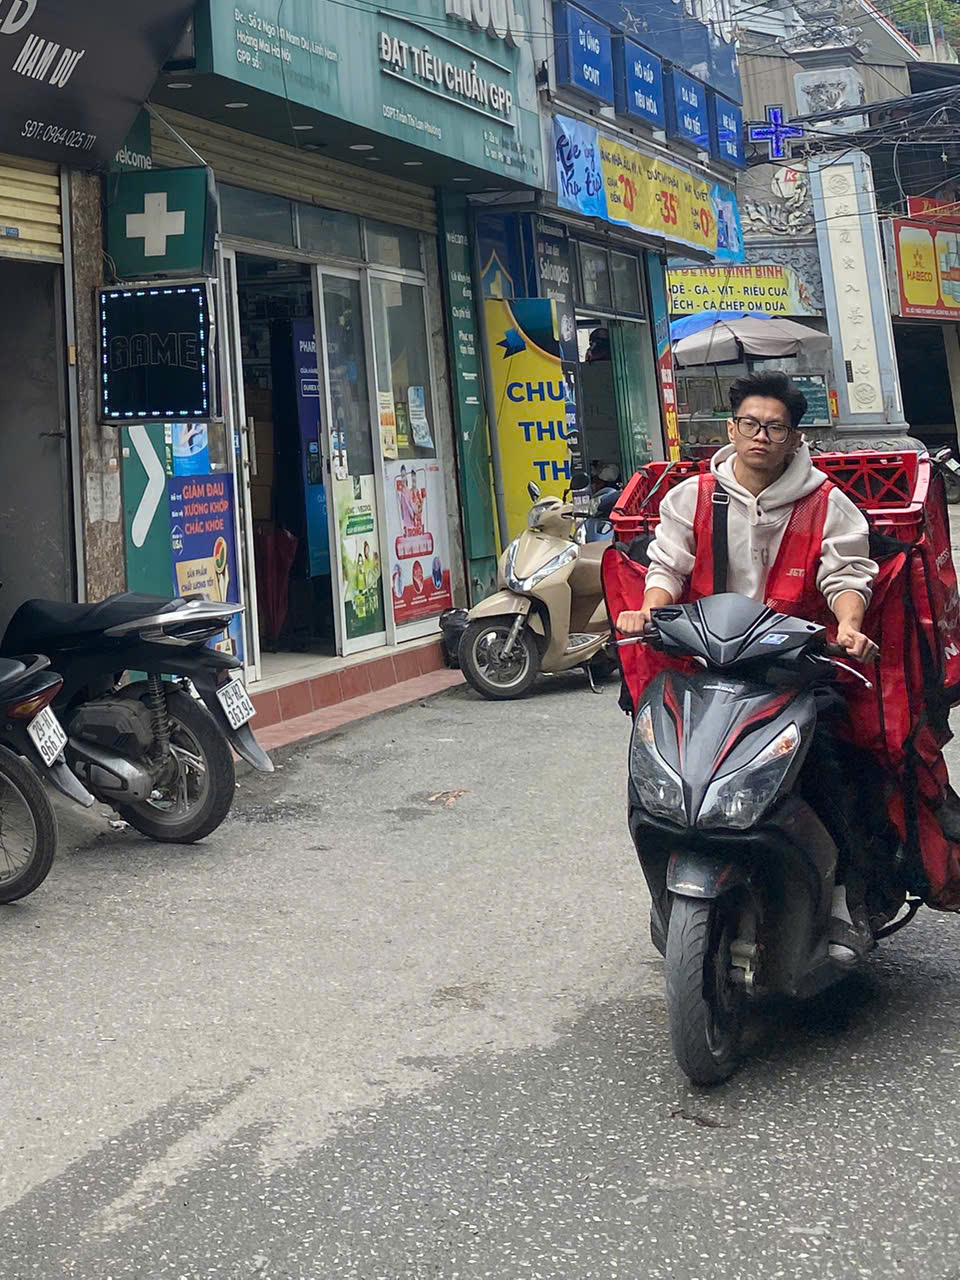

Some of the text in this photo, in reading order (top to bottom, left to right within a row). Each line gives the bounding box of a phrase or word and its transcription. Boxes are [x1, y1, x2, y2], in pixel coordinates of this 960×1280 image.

[236, 29, 259, 52] Hoàng
[258, 38, 272, 55] Mai
[286, 30, 302, 49] Nam
[14, 33, 59, 83] NAM
[378, 31, 514, 115] ĐẠT TIÊU CHUẨN GPP
[42, 124, 69, 145] 0964
[65, 130, 86, 148] 025
[767, 286, 789, 297] CUA
[747, 300, 763, 311] OM
[109, 332, 200, 372] GAME
[506, 381, 564, 403] CHU
[519, 421, 569, 442] THU
[533, 461, 571, 480] TH
[182, 480, 205, 500] GIẢM
[206, 482, 224, 497] ĐAU
[40, 729, 66, 763] 966.14
